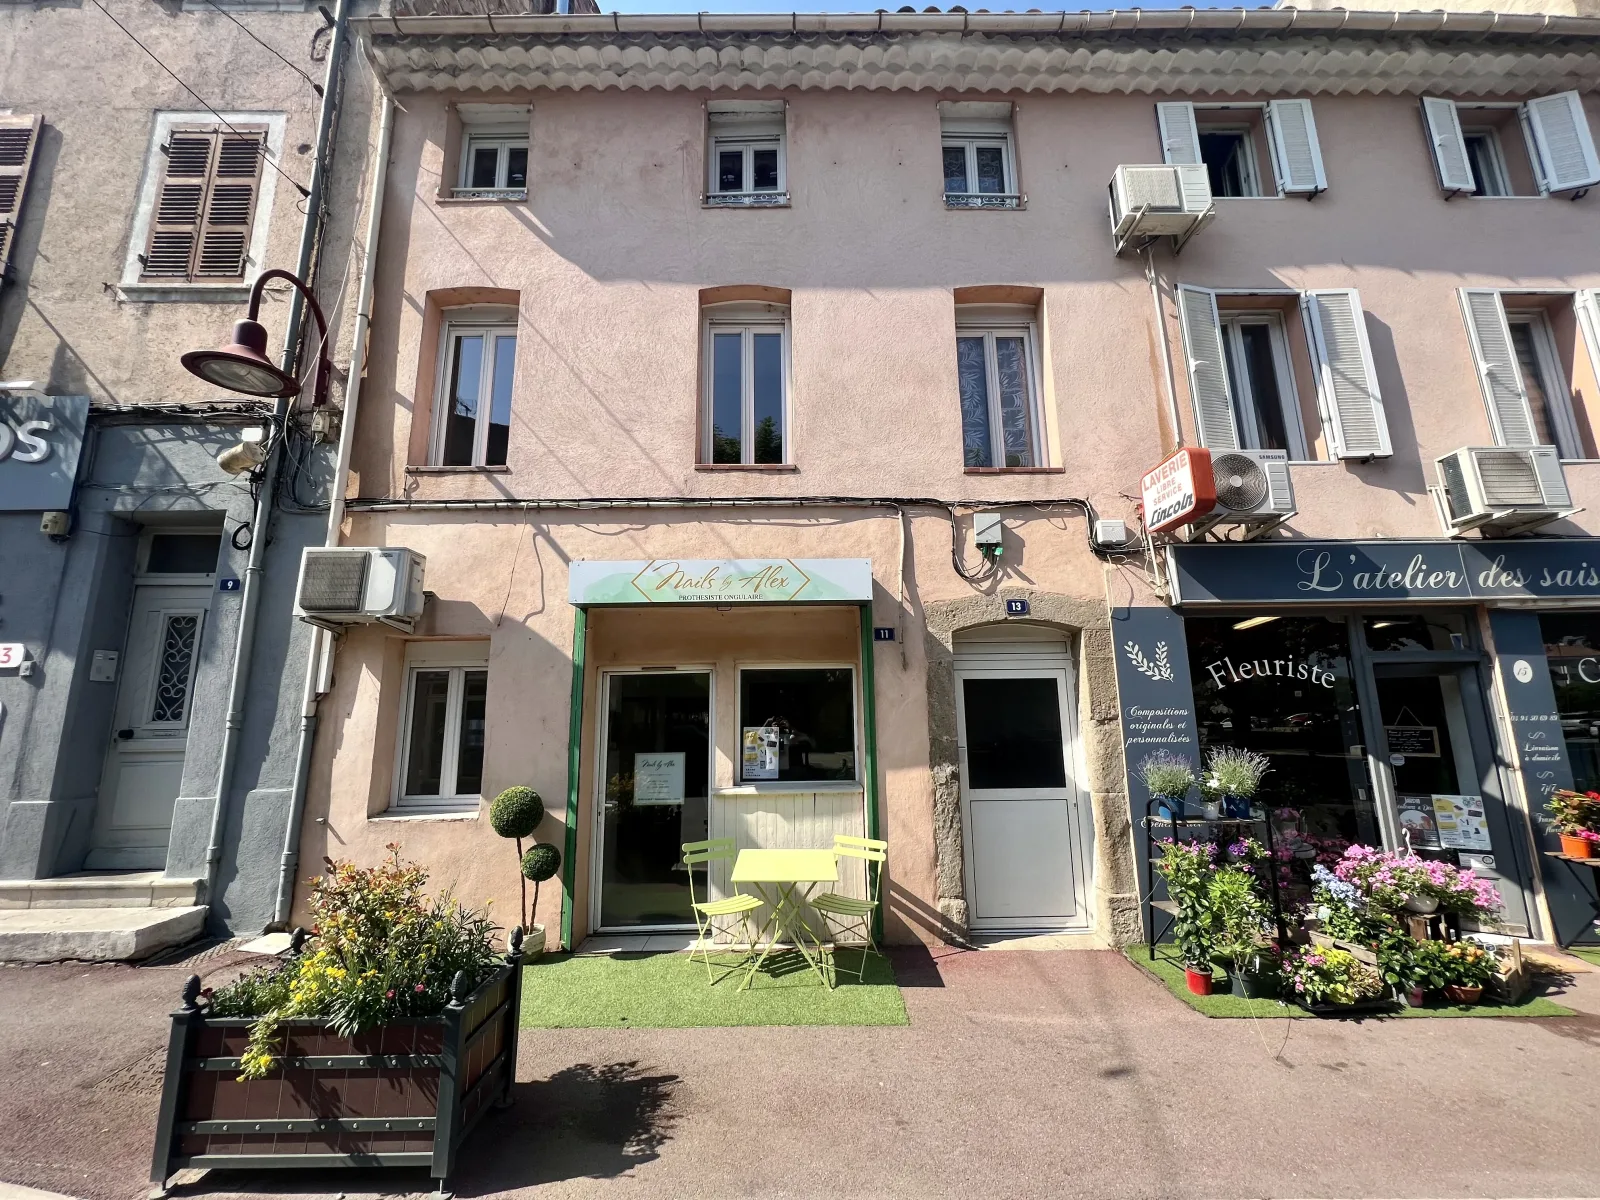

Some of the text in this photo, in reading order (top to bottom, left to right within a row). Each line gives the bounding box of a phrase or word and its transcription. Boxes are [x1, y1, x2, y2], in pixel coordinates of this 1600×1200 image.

[1143, 453, 1188, 491] LAVERIE
[1156, 476, 1177, 494] LIBRE
[1153, 482, 1183, 506] SERVICE
[1148, 493, 1194, 529] Lincoln
[652, 561, 790, 593] Nails by Alex
[1296, 548, 1466, 592] L'atelier
[1478, 554, 1532, 588] des
[227, 580, 234, 590] 9
[1011, 602, 1022, 611] 13
[880, 629, 889, 639] 11
[1205, 654, 1336, 690] Fleuriste
[1516, 666, 1529, 676] 15
[1125, 705, 1189, 720] Compositions
[1129, 718, 1188, 734] originales et
[1125, 732, 1191, 748] personnalisées
[1524, 743, 1559, 752] Livraison
[1531, 752, 1561, 761] domicile
